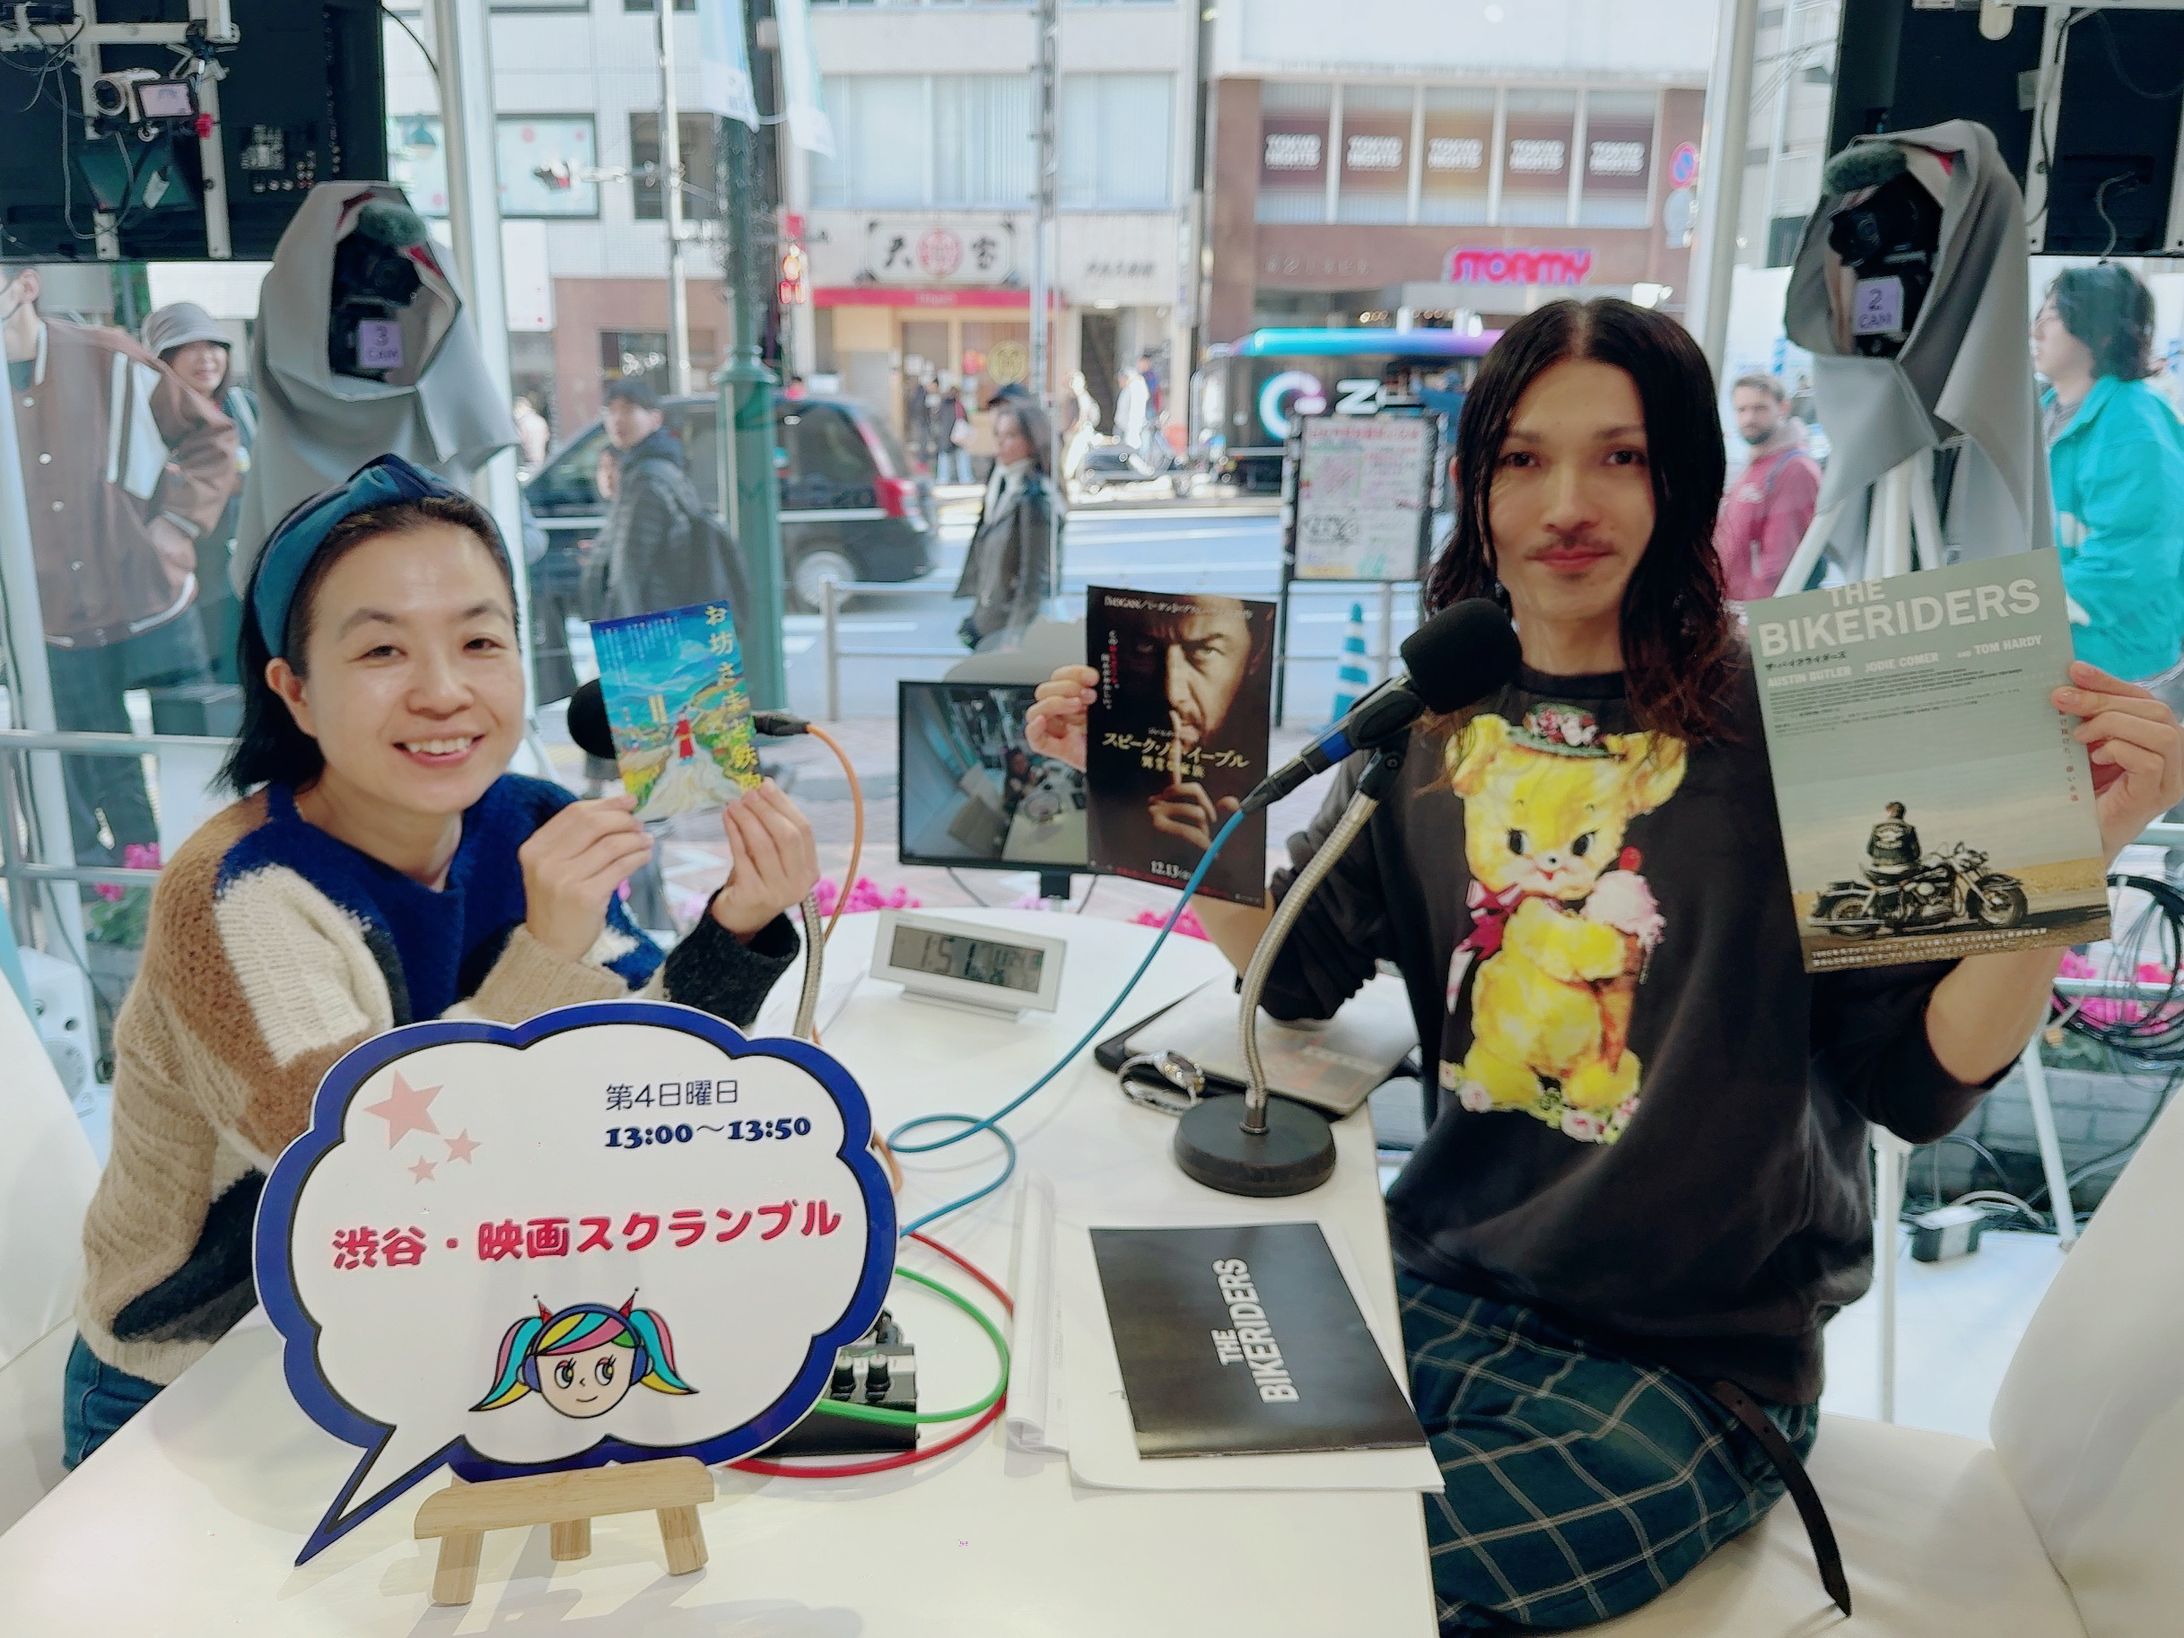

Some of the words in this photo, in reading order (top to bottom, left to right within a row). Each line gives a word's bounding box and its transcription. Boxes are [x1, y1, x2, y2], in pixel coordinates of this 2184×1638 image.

[1451, 249, 1593, 285] STORMY
[1870, 289, 1882, 310] 2
[1827, 578, 1886, 608] THE
[1757, 578, 2041, 658] BIKERIDERS
[1766, 673, 1807, 690] AUSTIN
[1809, 664, 1852, 684] BUTLER
[1864, 658, 1896, 675] JODIE
[1899, 651, 1940, 669] COMER
[1974, 642, 2000, 657] TOM
[2002, 634, 2043, 653] HARDY
[604, 1079, 739, 1111] 第4日曜日
[331, 1199, 843, 1271] 渋谷・映画スクランブル
[1210, 1328, 1245, 1366] THE
[1212, 1258, 1300, 1403] BIKERIDERS
